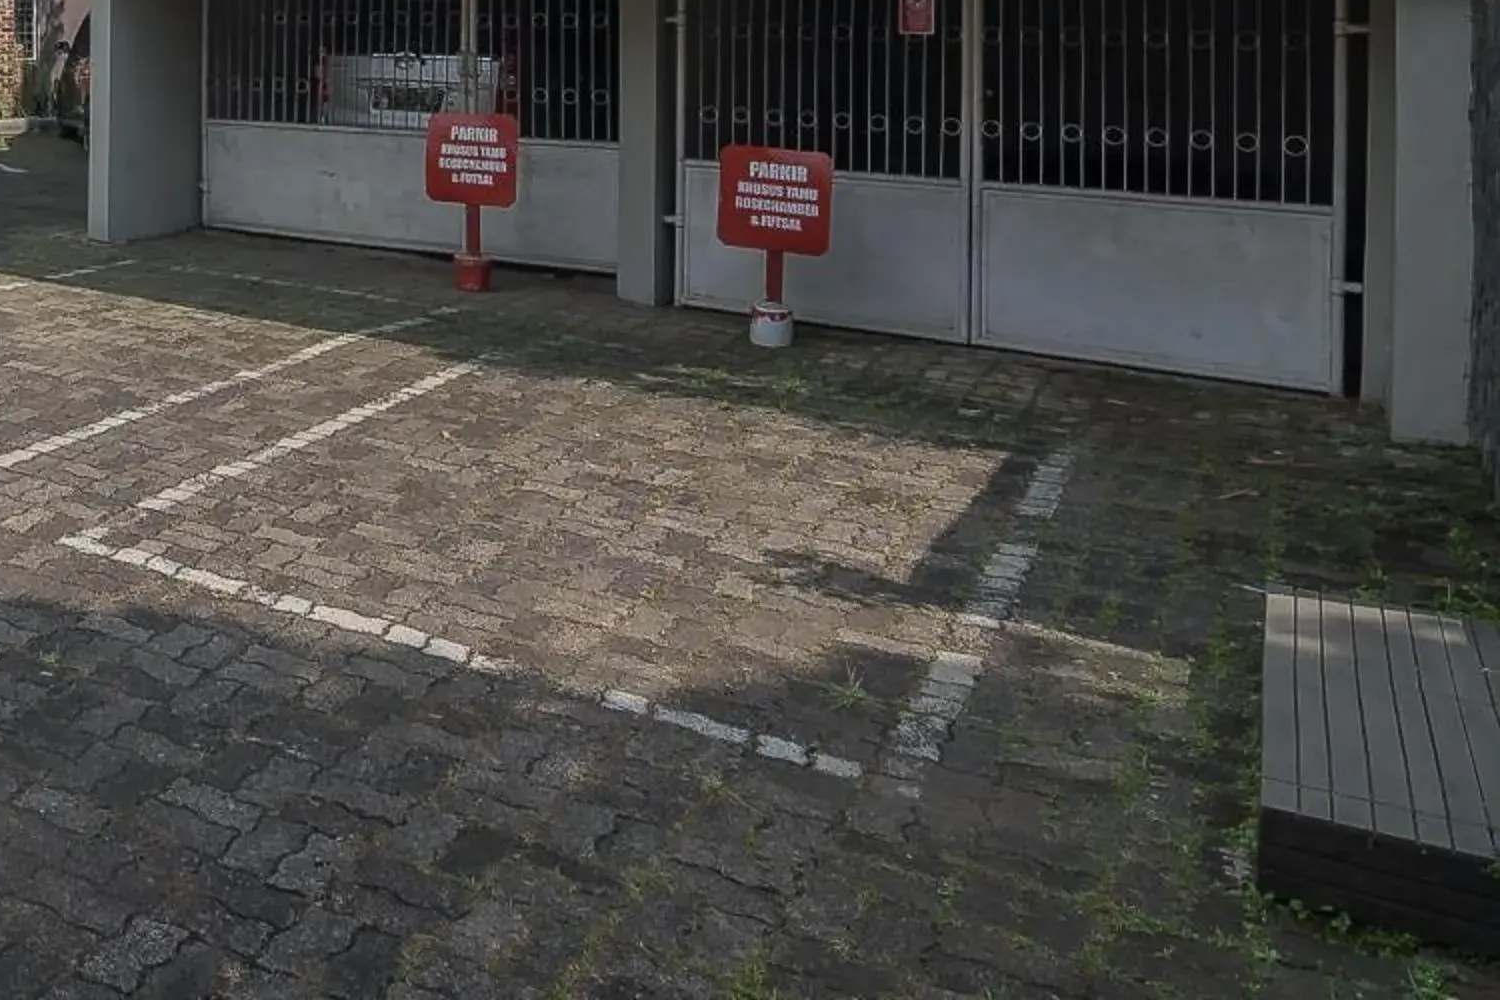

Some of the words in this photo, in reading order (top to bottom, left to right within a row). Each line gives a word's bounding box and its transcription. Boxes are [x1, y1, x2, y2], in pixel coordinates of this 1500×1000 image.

[451, 126, 498, 142] PARKIR
[459, 173, 494, 186] FUTSAL
[749, 161, 808, 183] PARKIR
[737, 180, 784, 197] KHUSUS
[786, 186, 819, 201] TAMU
[761, 215, 802, 231] FUTSAL
